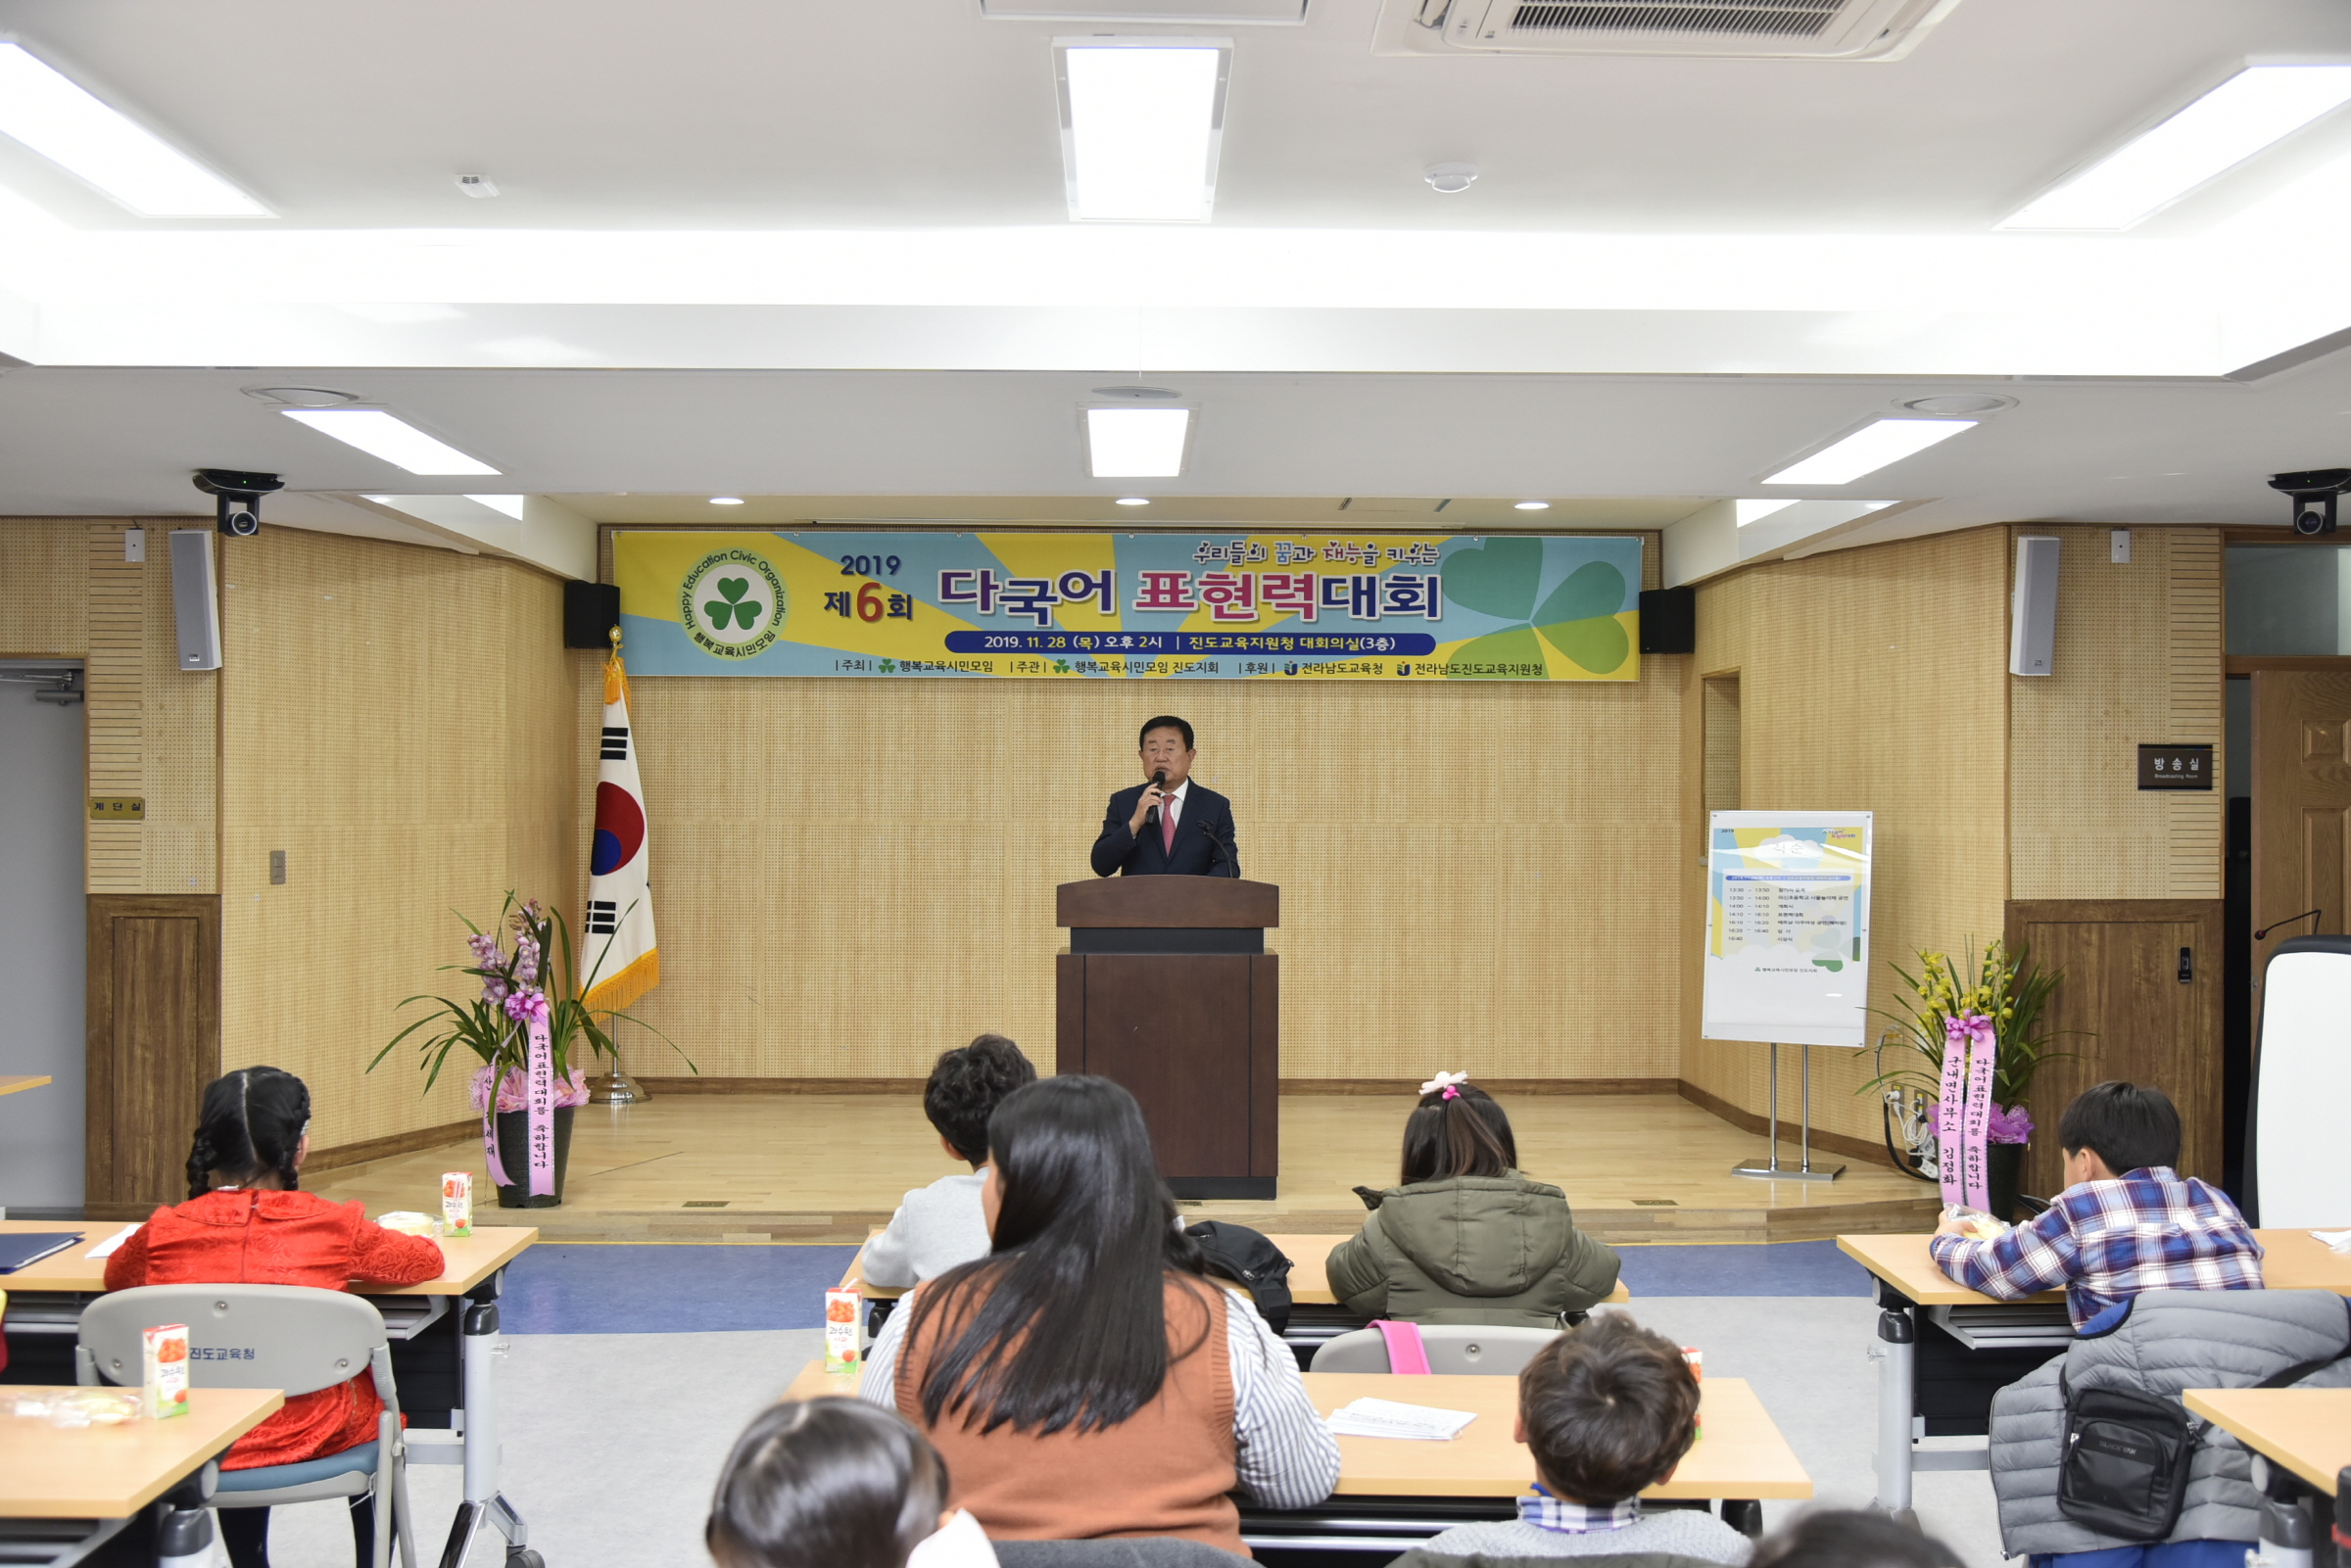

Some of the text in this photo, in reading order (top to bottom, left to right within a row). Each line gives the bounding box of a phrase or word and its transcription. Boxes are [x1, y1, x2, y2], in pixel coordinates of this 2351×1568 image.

[1193, 541, 1439, 565] 우리들의 꿈과 재능을 키우는
[840, 554, 901, 576] 2019
[682, 549, 786, 630] Happy Education Civic Organization
[938, 569, 1116, 627] 다국어
[694, 630, 776, 657] 행복교육시민모임
[984, 635, 1396, 651] 2019. 11. 28 (목) 오후 2시 진도교육지원청 대회의실(3층)
[899, 660, 994, 673] 행복교육시민모임
[1075, 660, 1169, 674] 행복교육시민모임
[1173, 661, 1219, 675] 진도지회
[1302, 662, 1383, 675] 전라남도교육청
[1415, 663, 1543, 676] 전라남도진도교육지원청
[1943, 1056, 1962, 1186] 군내면사무소 김정화
[190, 1348, 255, 1360] 진도교육청
